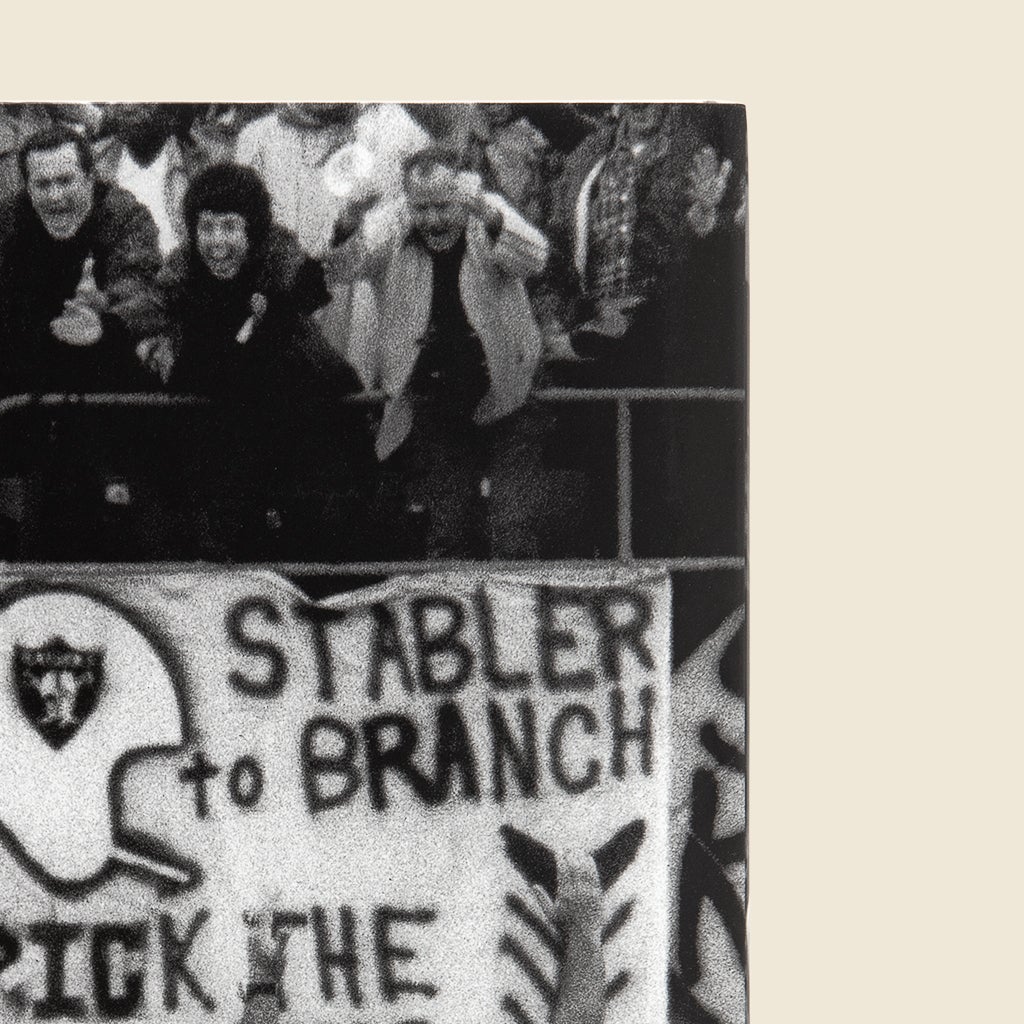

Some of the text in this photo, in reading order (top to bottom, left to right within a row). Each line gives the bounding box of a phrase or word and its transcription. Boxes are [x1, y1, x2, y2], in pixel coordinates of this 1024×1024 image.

[225, 583, 660, 702] STABLER
[178, 686, 658, 819] to BRANCH
[240, 903, 440, 1012] THE
